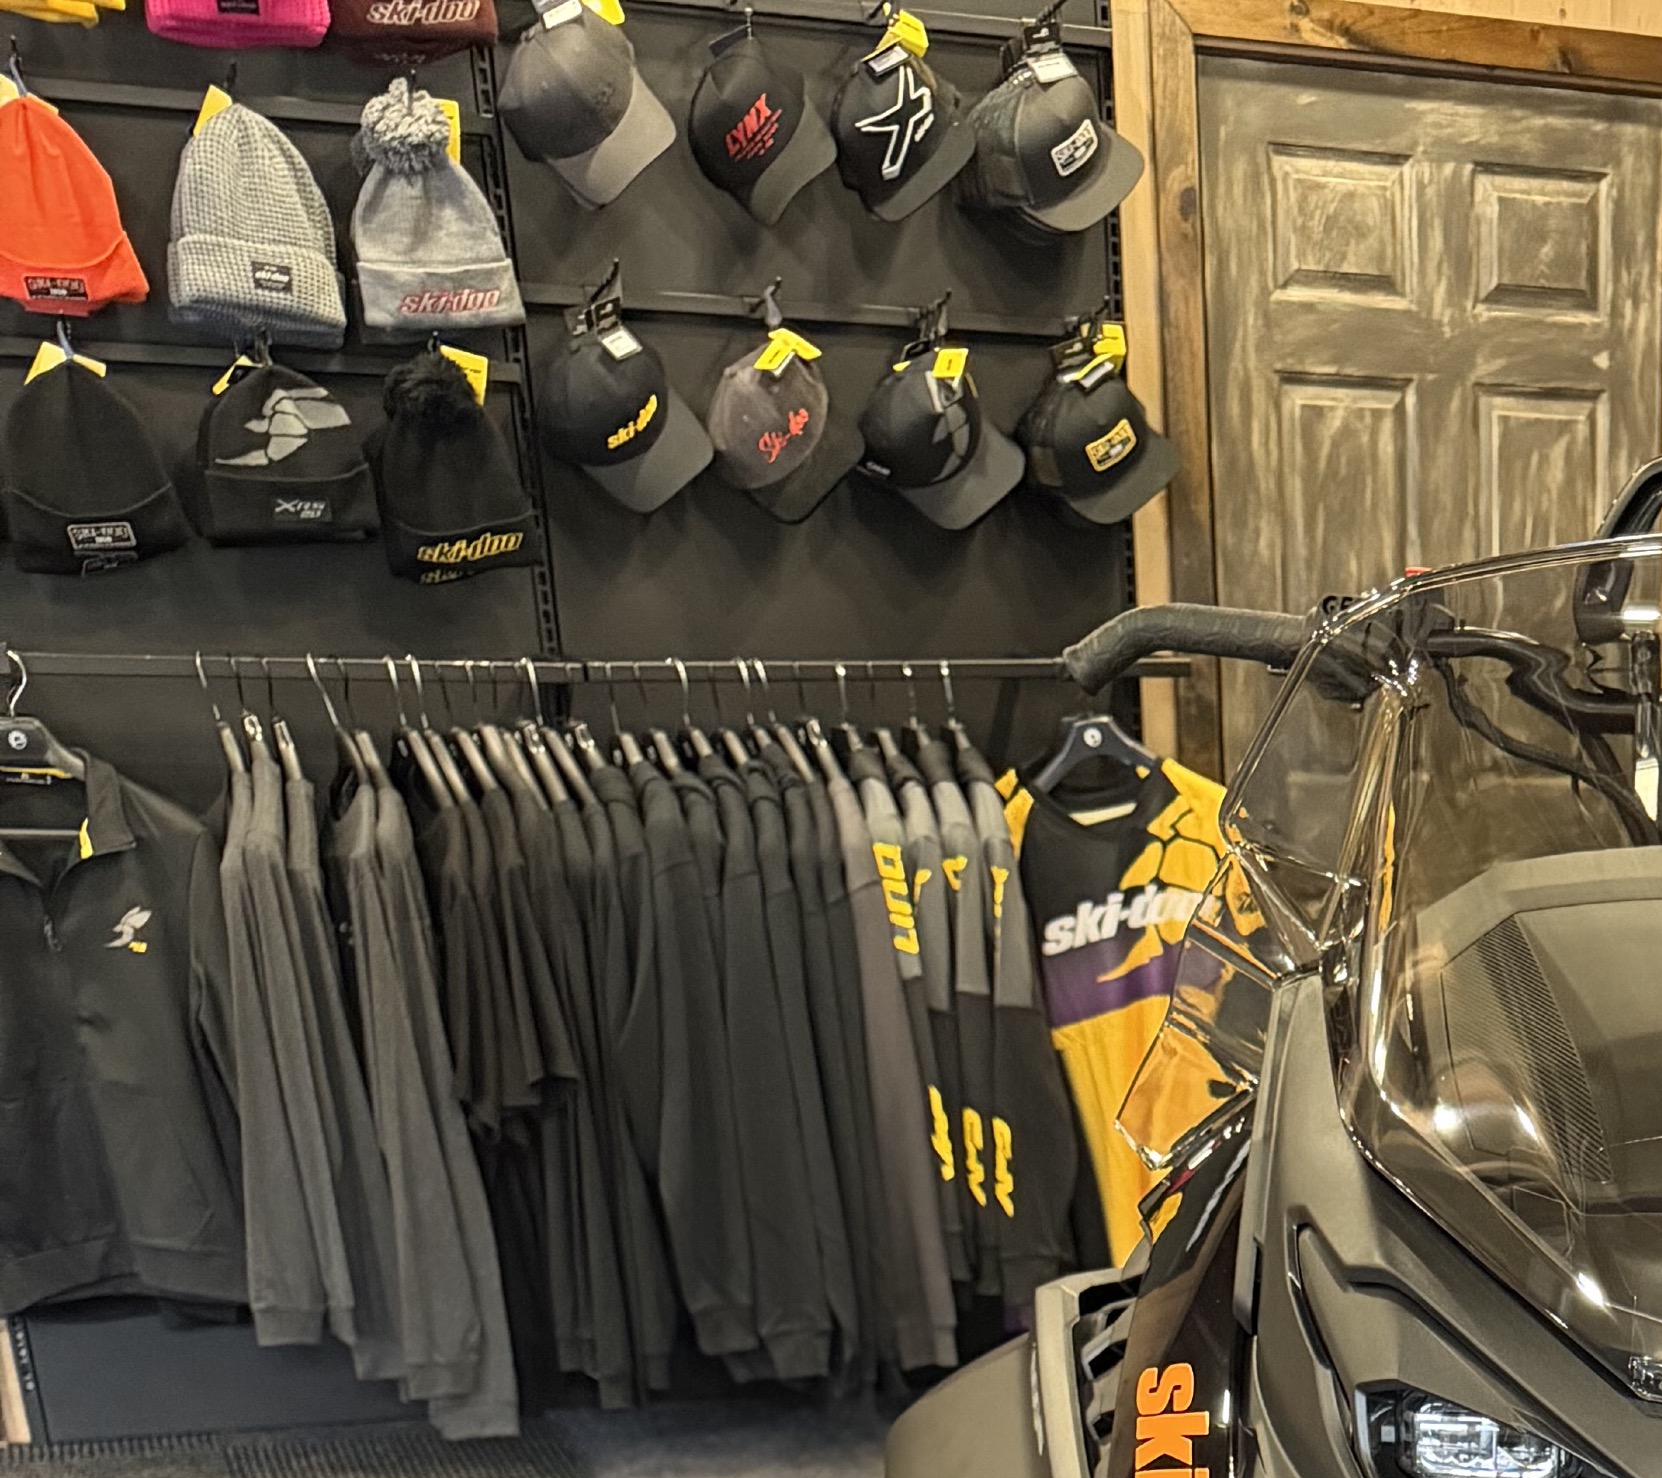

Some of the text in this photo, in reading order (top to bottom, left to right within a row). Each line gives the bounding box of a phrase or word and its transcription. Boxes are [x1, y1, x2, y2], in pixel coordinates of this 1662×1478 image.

[400, 288, 501, 316] ski-doo
[417, 532, 524, 564] ski-doo
[1042, 883, 1208, 957] ski-doo
